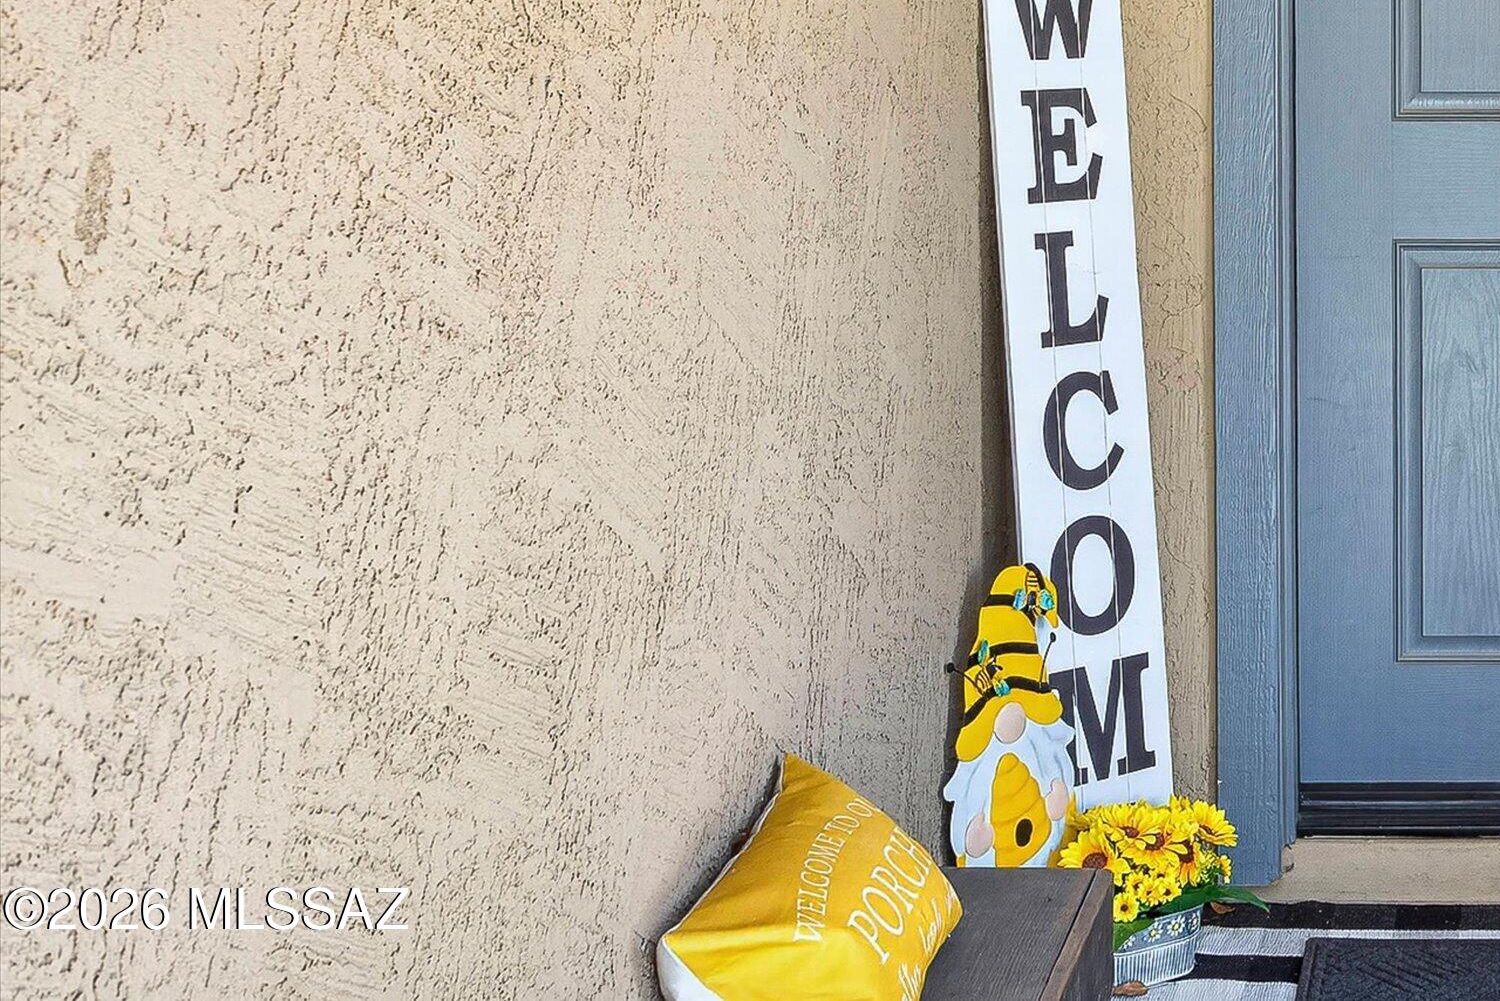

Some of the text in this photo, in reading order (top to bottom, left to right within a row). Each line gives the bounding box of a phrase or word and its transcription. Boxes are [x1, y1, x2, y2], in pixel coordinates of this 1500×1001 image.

[792, 832, 846, 942] WELCOME
[824, 814, 861, 835] TO
[848, 826, 932, 964] PORCH
